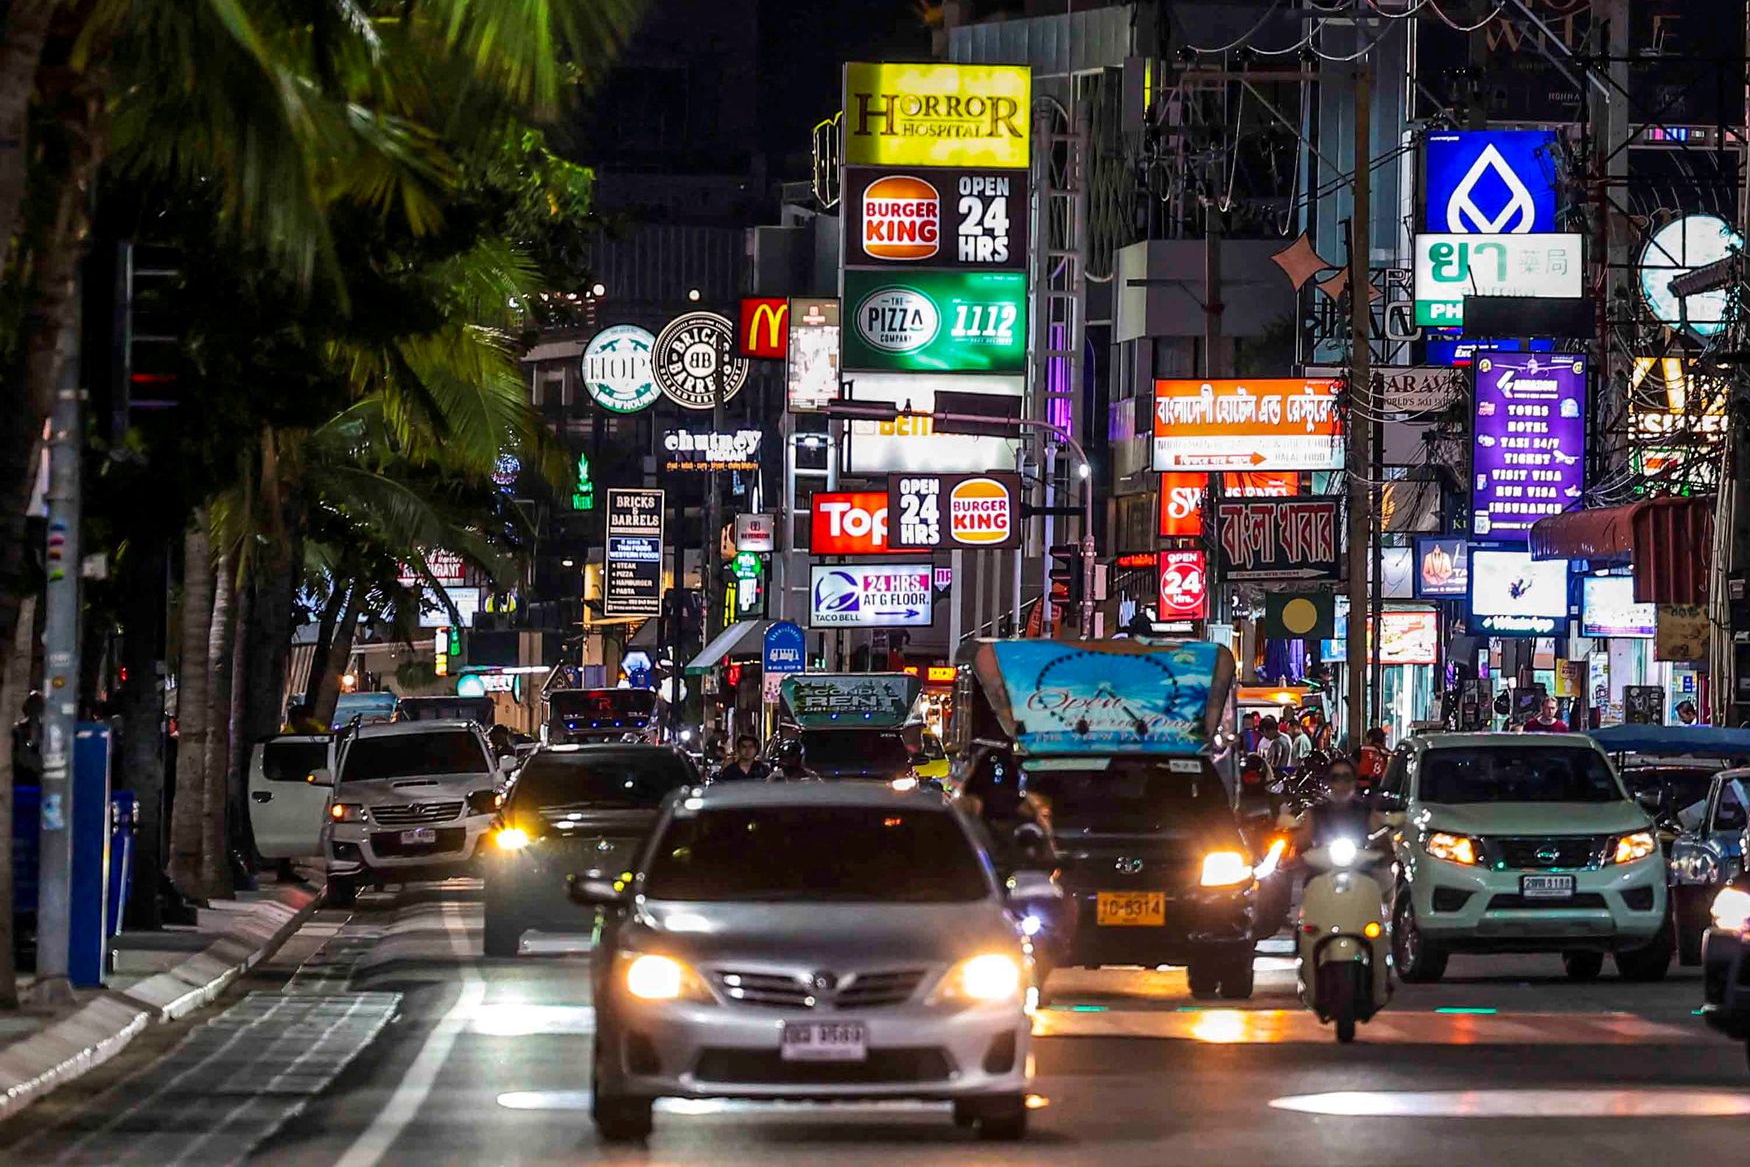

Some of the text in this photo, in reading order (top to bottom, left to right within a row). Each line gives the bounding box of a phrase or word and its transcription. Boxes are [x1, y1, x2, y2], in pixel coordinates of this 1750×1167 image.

[854, 93, 1024, 138] HORROR
[902, 122, 986, 139] HOSPITAL
[959, 176, 1010, 196] OPEN
[866, 202, 938, 218] BURGER
[958, 196, 1010, 236] 24
[866, 220, 938, 243] KING
[958, 236, 1009, 262] HRS
[1428, 242, 1508, 283] ยา
[891, 297, 904, 305] THE
[868, 308, 924, 333] PIZZA
[951, 305, 1018, 337] 1112
[880, 335, 912, 343] COMPANY
[588, 356, 654, 381] HOP
[900, 478, 939, 494] OPEN
[616, 495, 655, 508] BRICKS
[900, 494, 940, 525] 24
[953, 500, 1007, 513] BURGER
[632, 507, 639, 515] &
[611, 514, 660, 527] BARRELS
[953, 513, 1008, 530] KING
[900, 524, 940, 545] HRS
[1167, 552, 1197, 563] OPEN
[616, 570, 634, 578] PIZZA
[616, 579, 652, 587] HAMBURGER
[867, 574, 925, 592] 24 HRS.
[1163, 571, 1202, 595] 24
[863, 592, 930, 606] AT G FLOOR.
[1173, 593, 1194, 604] Hrs.
[815, 614, 860, 622] TACO BELL
[805, 695, 899, 706] RENT
[1027, 688, 1123, 714] Open
